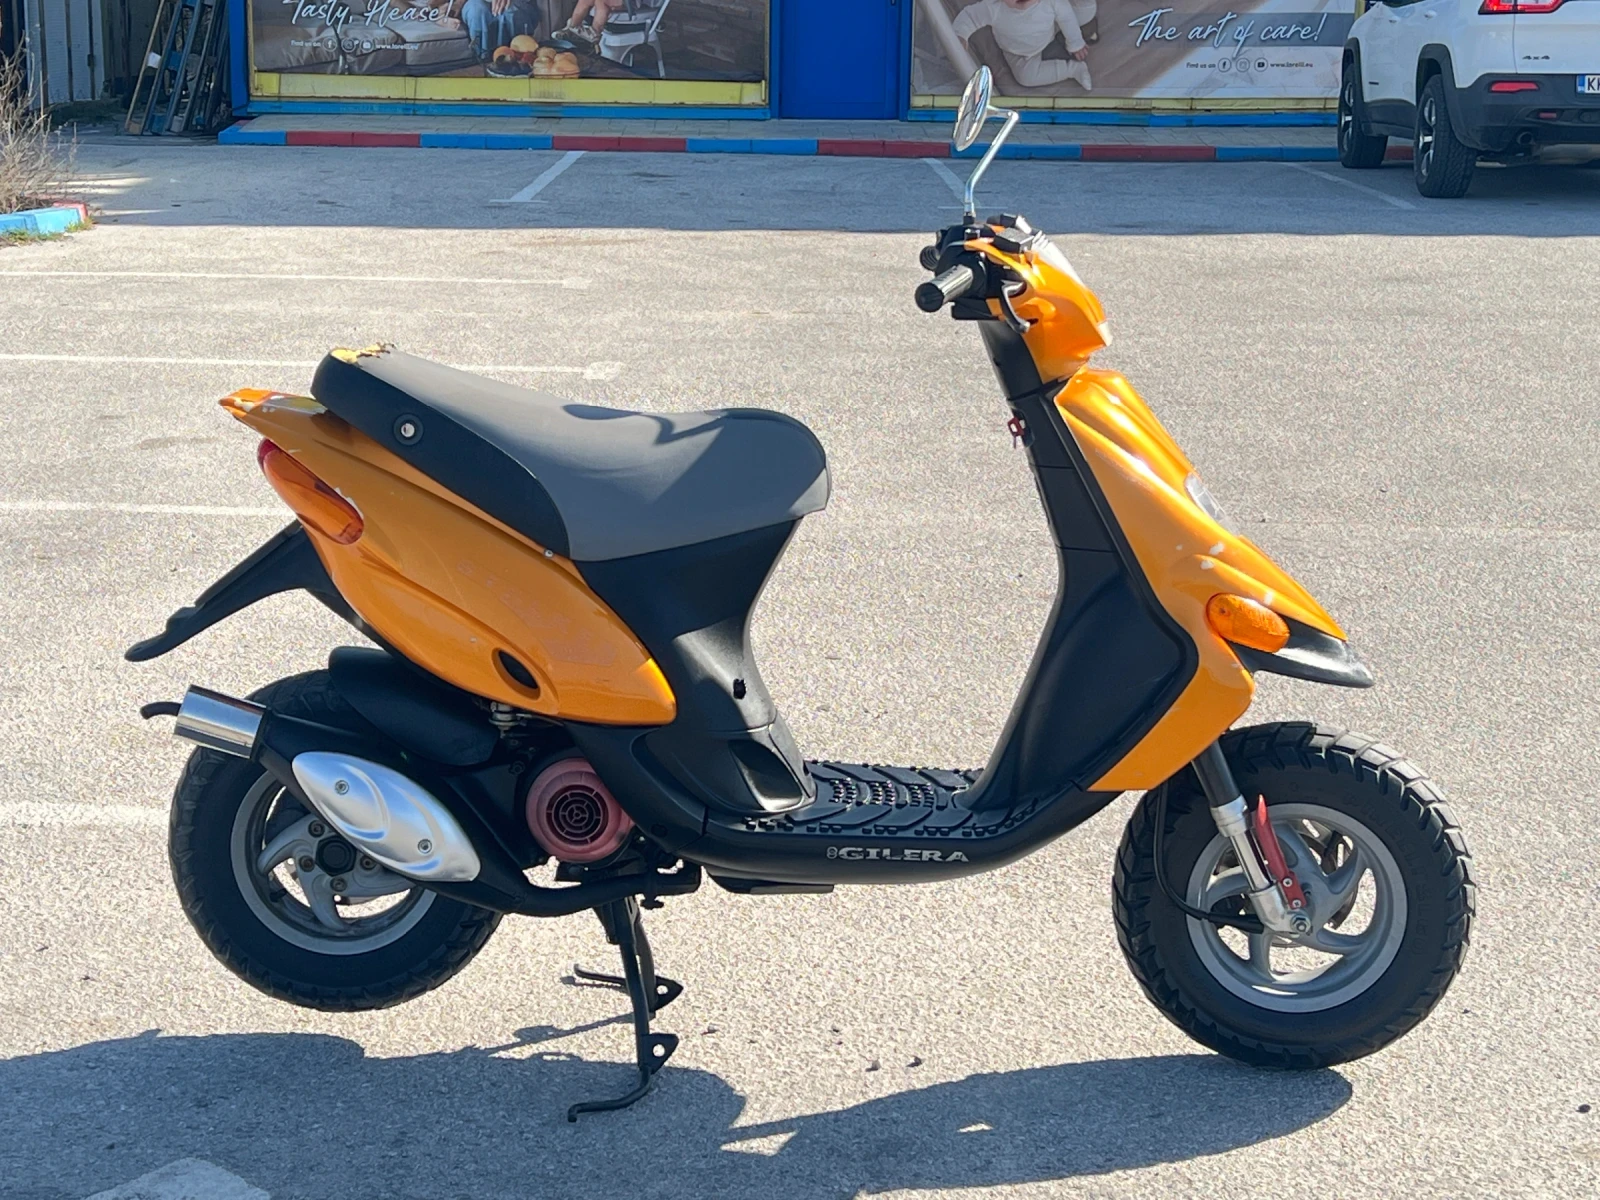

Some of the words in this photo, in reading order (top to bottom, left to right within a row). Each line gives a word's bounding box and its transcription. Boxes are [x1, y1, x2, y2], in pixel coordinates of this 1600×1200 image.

[1128, 8, 1182, 47] The
[1187, 11, 1237, 48] art
[1233, 20, 1254, 58] of
[1260, 12, 1328, 41] care!
[838, 847, 969, 862] GILERA
